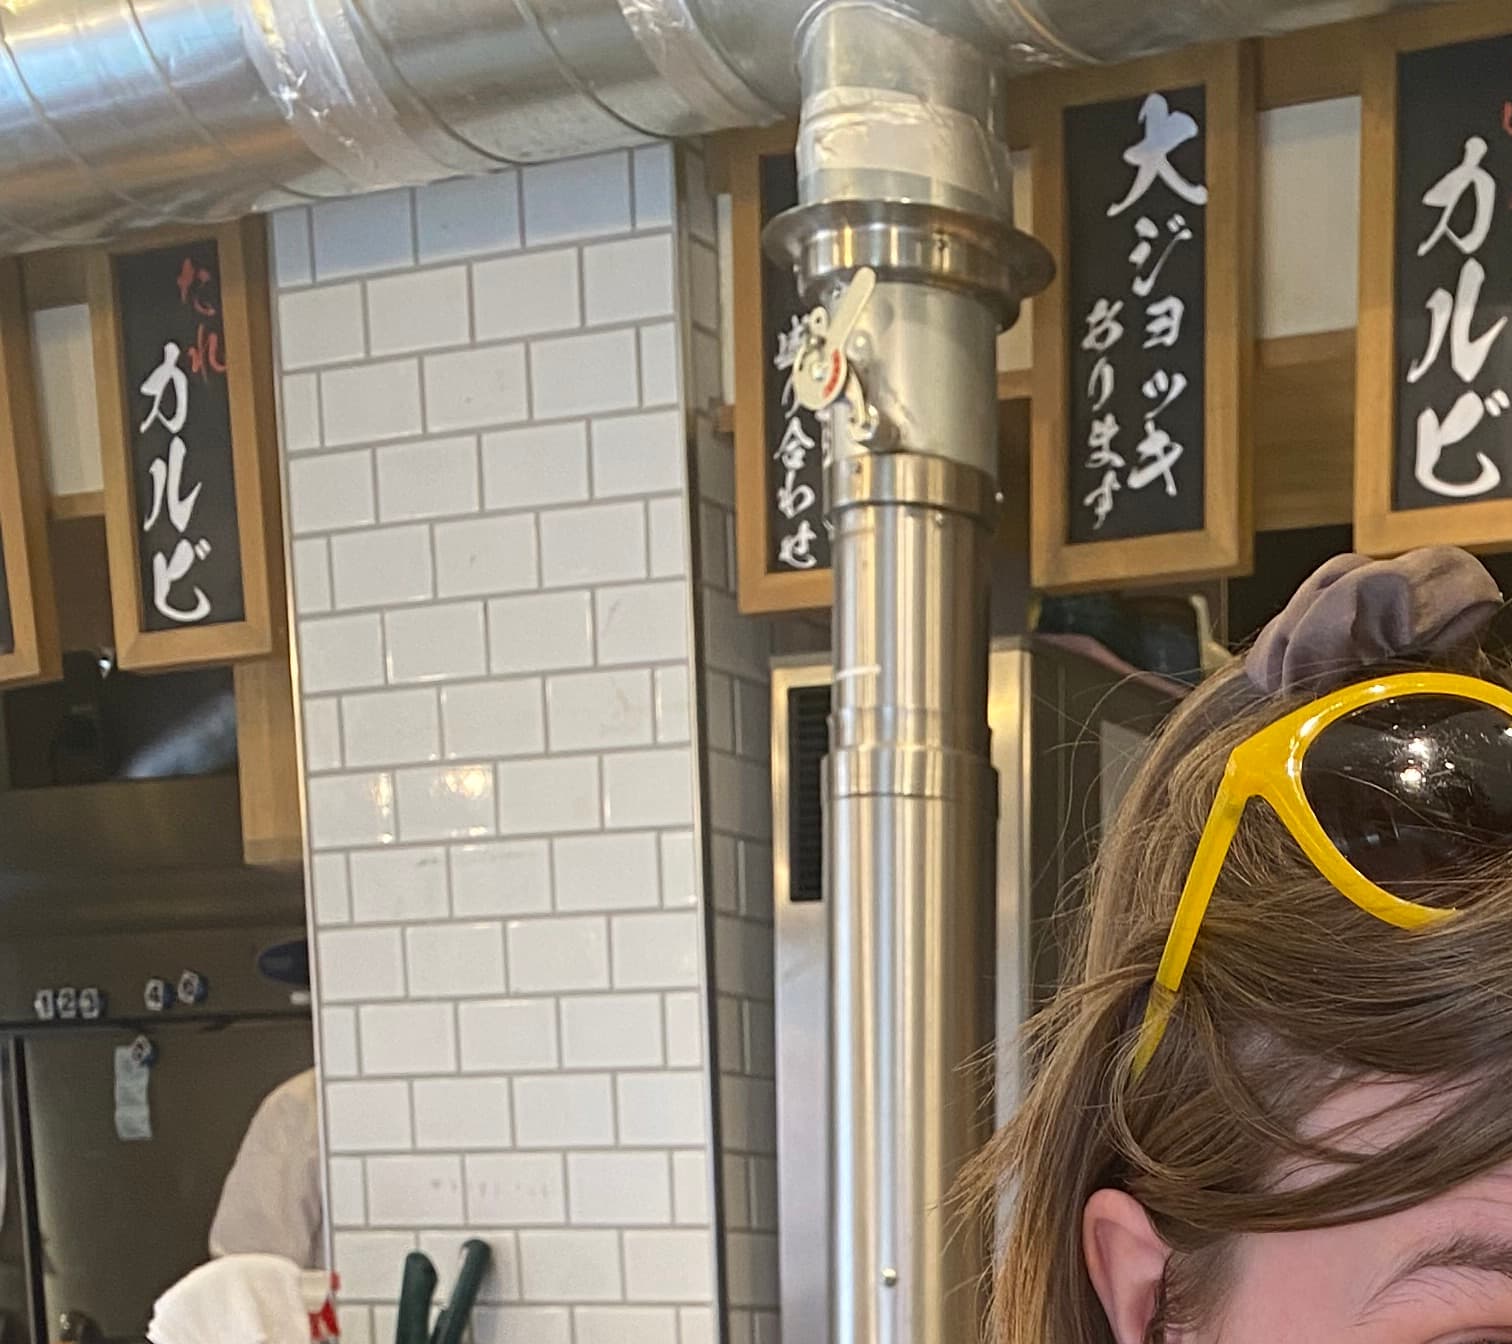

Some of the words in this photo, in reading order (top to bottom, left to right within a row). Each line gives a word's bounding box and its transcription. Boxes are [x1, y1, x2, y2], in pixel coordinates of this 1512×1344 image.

[1407, 136, 1510, 497] カルビ
[139, 341, 211, 622] カルビ
